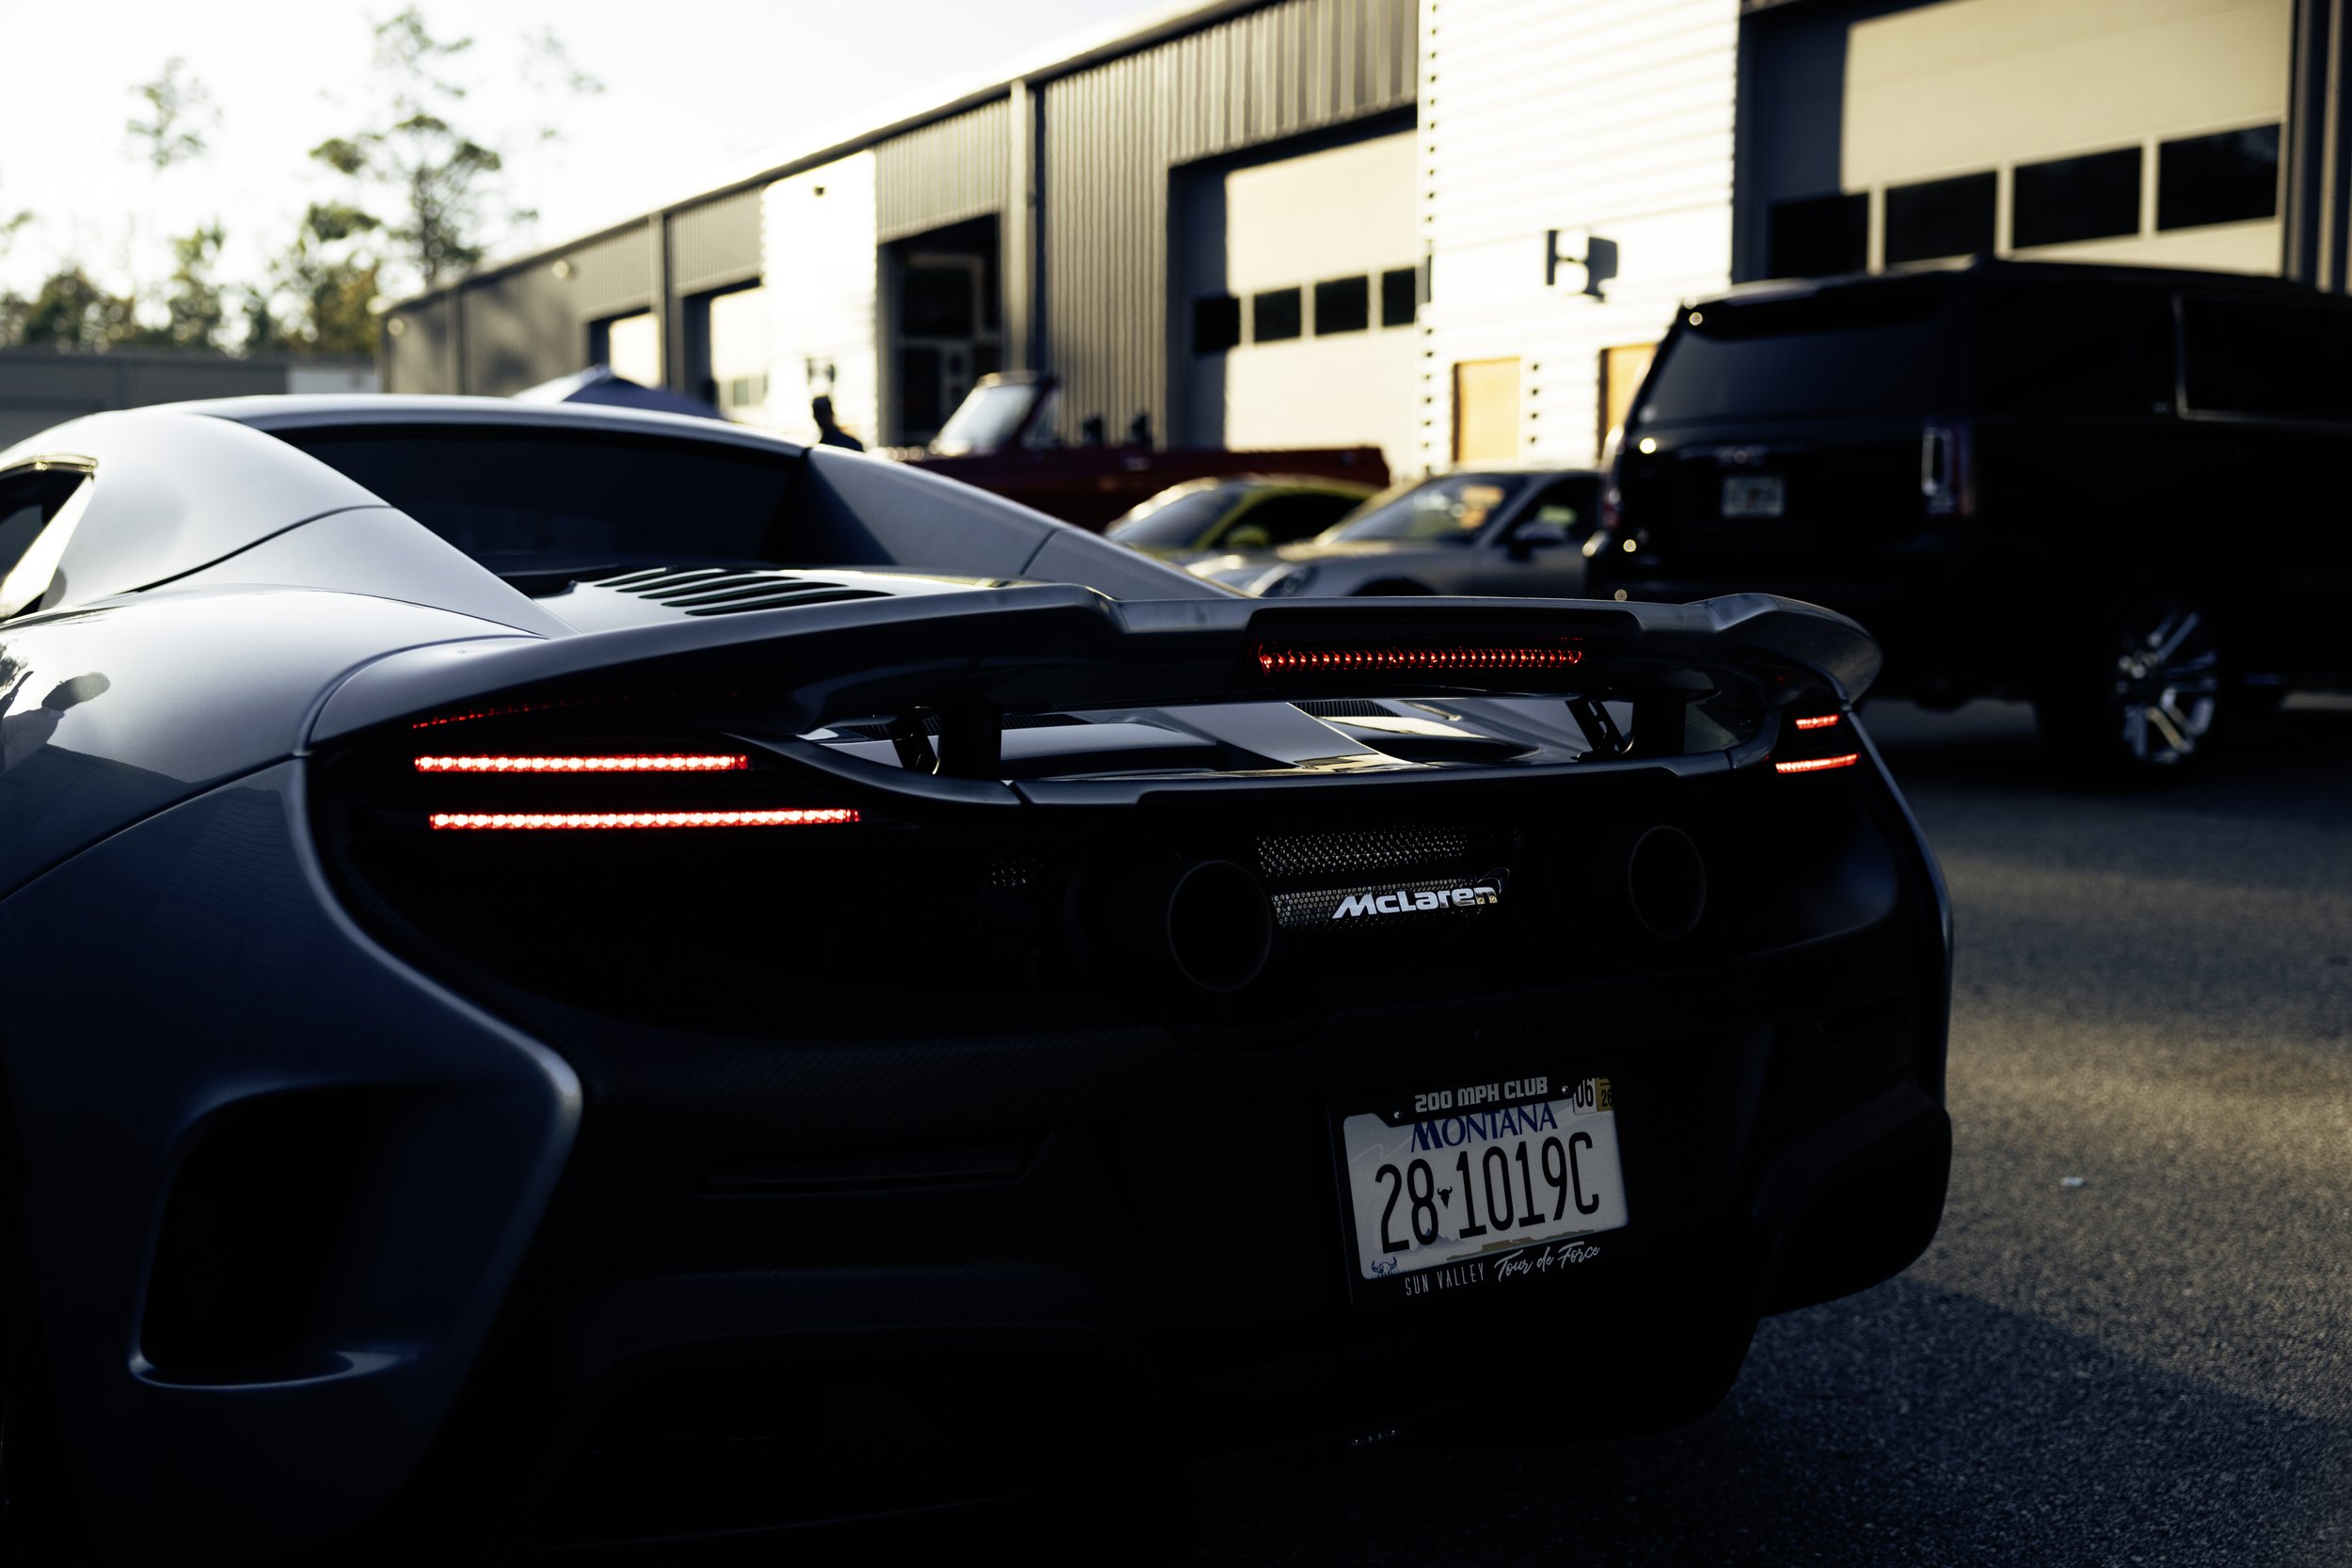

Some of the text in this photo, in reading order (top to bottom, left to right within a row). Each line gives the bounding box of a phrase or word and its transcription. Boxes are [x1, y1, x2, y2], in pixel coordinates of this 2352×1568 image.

[1332, 886, 1498, 919] McLaren
[1414, 1076, 1549, 1114] 200 MPH CLUB
[1411, 1101, 1558, 1153] MONTANA
[1404, 1241, 1600, 1296] SUN VALLEY Tour de Force
